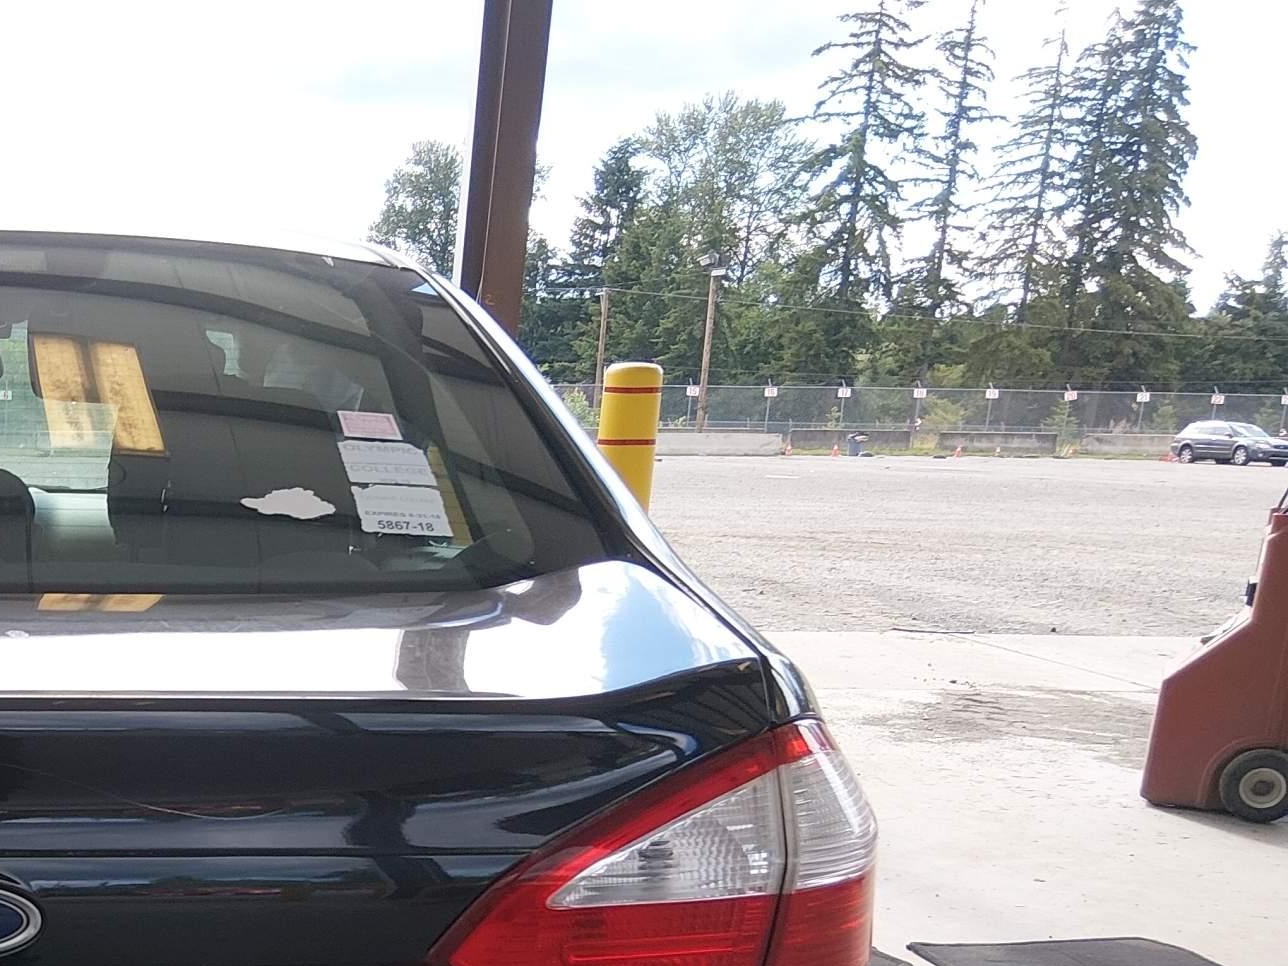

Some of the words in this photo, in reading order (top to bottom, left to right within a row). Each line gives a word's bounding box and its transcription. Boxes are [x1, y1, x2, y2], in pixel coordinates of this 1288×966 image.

[343, 443, 418, 456] OLYMPIC
[350, 464, 427, 475] COLLEGE
[377, 520, 434, 532] 5867-18
